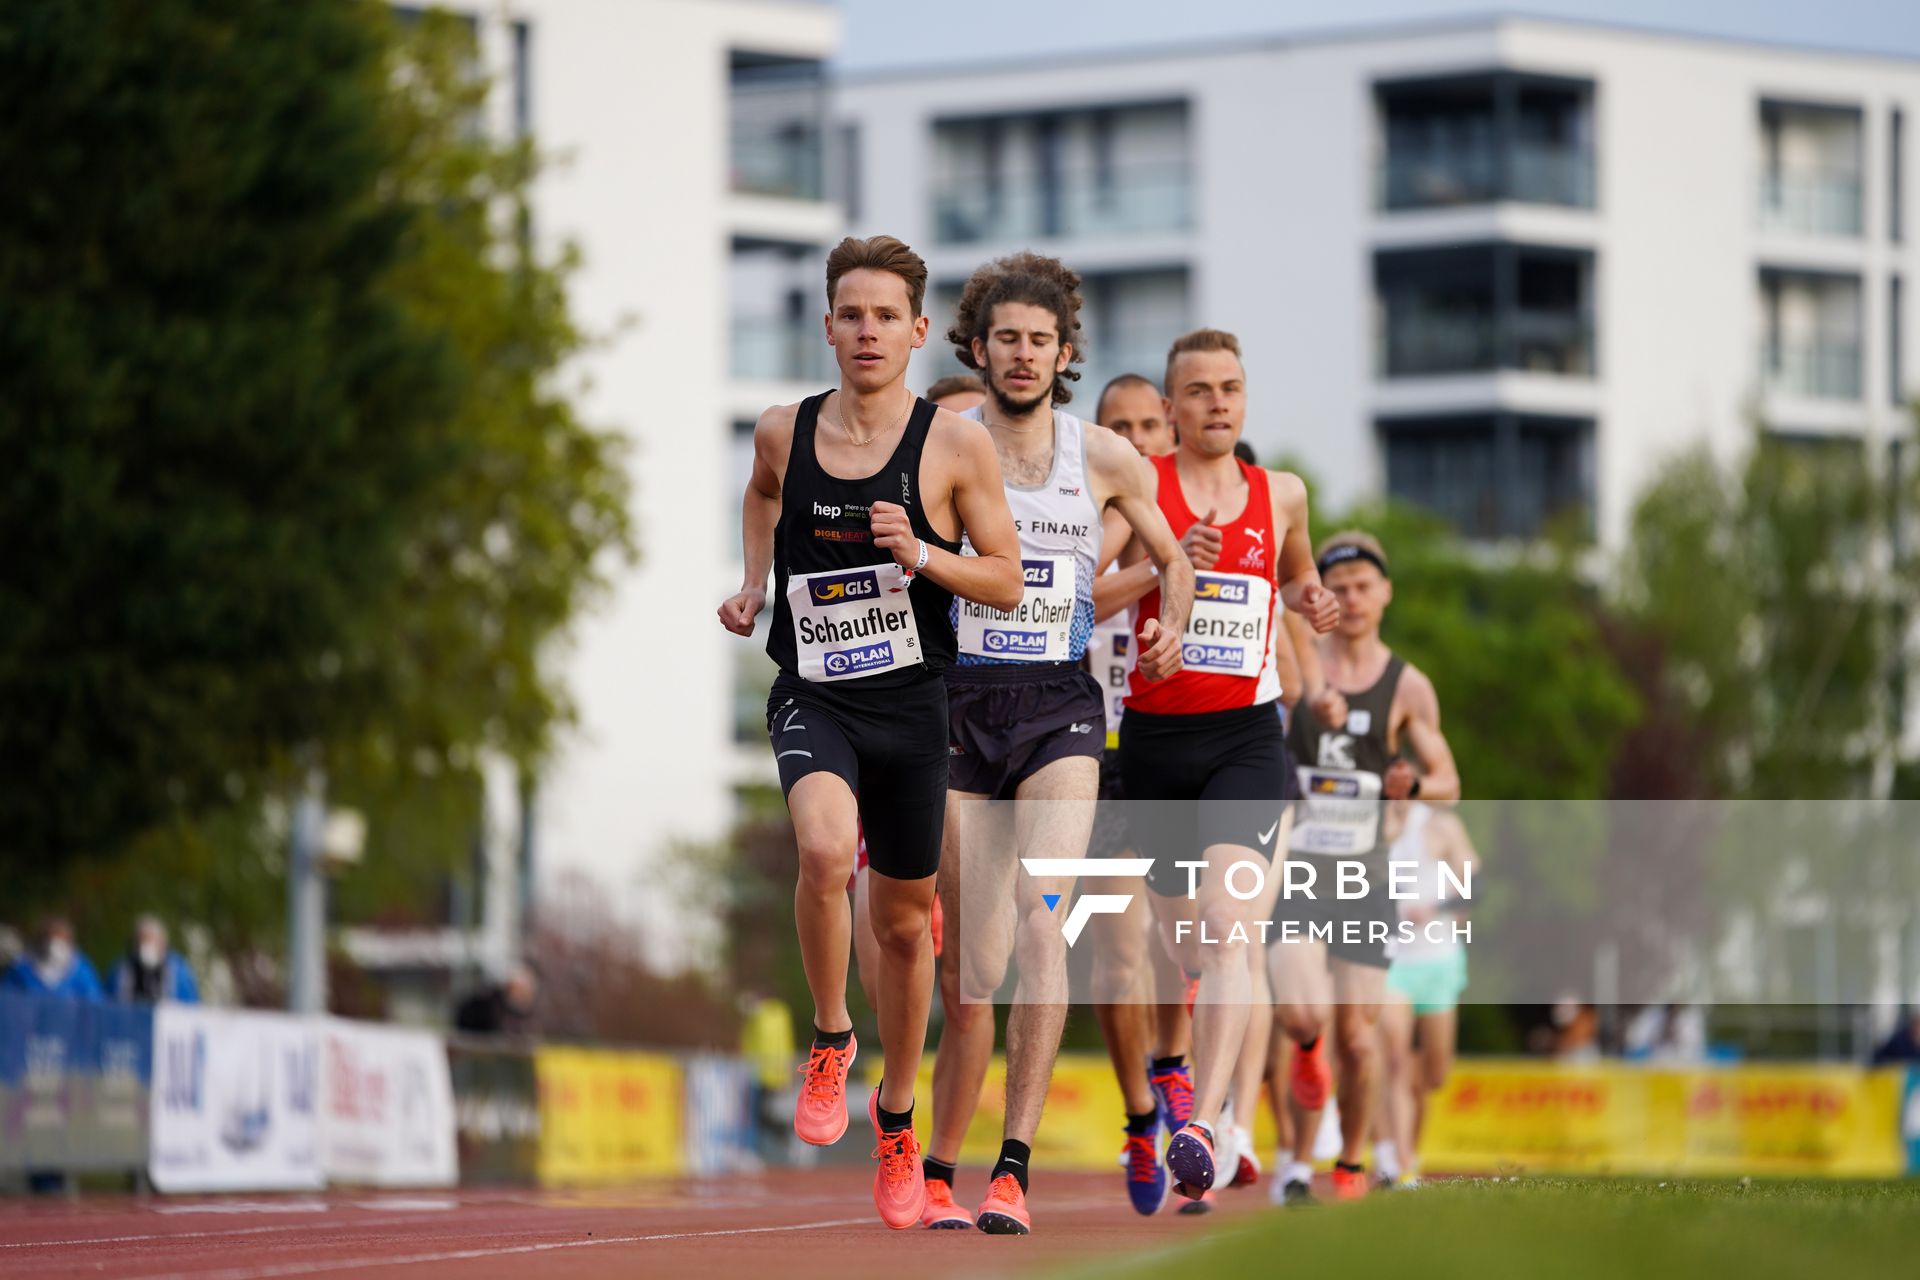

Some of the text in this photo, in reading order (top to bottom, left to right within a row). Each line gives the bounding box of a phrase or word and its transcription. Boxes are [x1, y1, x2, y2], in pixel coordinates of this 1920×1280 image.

[901, 472, 911, 505] 2XU
[813, 501, 841, 519] hep
[1032, 521, 1088, 537] FINANZ
[1024, 567, 1049, 583] GLS
[845, 579, 872, 596] GLS
[1220, 584, 1245, 600] GLS
[1032, 597, 1071, 624] Cherif
[799, 607, 908, 645] Schaufler
[1185, 617, 1262, 640] enzel
[1009, 634, 1045, 647] PLAN
[850, 646, 890, 664] PLAN
[1206, 647, 1242, 662] PLAN
[853, 658, 891, 670] INTERNATIONAL
